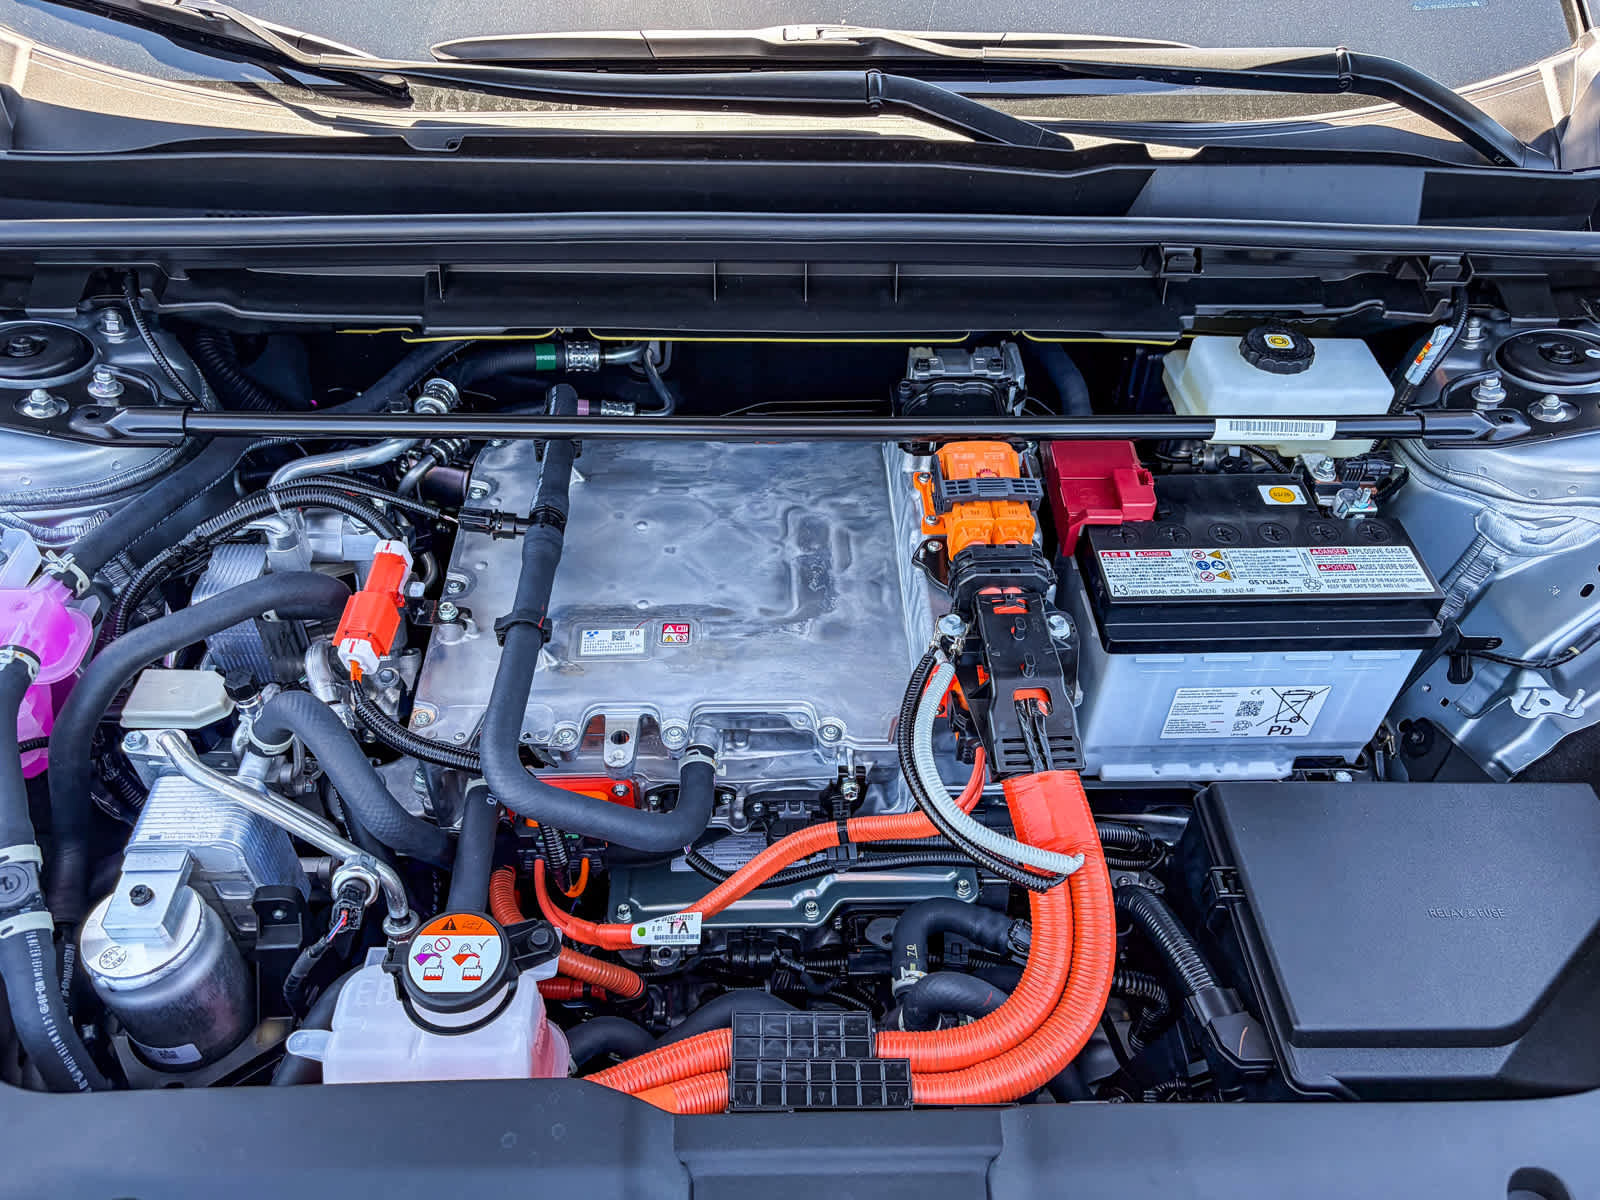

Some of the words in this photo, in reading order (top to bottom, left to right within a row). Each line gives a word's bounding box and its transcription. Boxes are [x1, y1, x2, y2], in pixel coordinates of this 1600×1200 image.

[1113, 585, 1129, 596] A3
[1267, 725, 1293, 736] Pb
[1427, 908, 1463, 919] RELAY
[1476, 908, 1505, 919] FUSE
[667, 920, 689, 934] TA
[906, 944, 917, 959] 70
